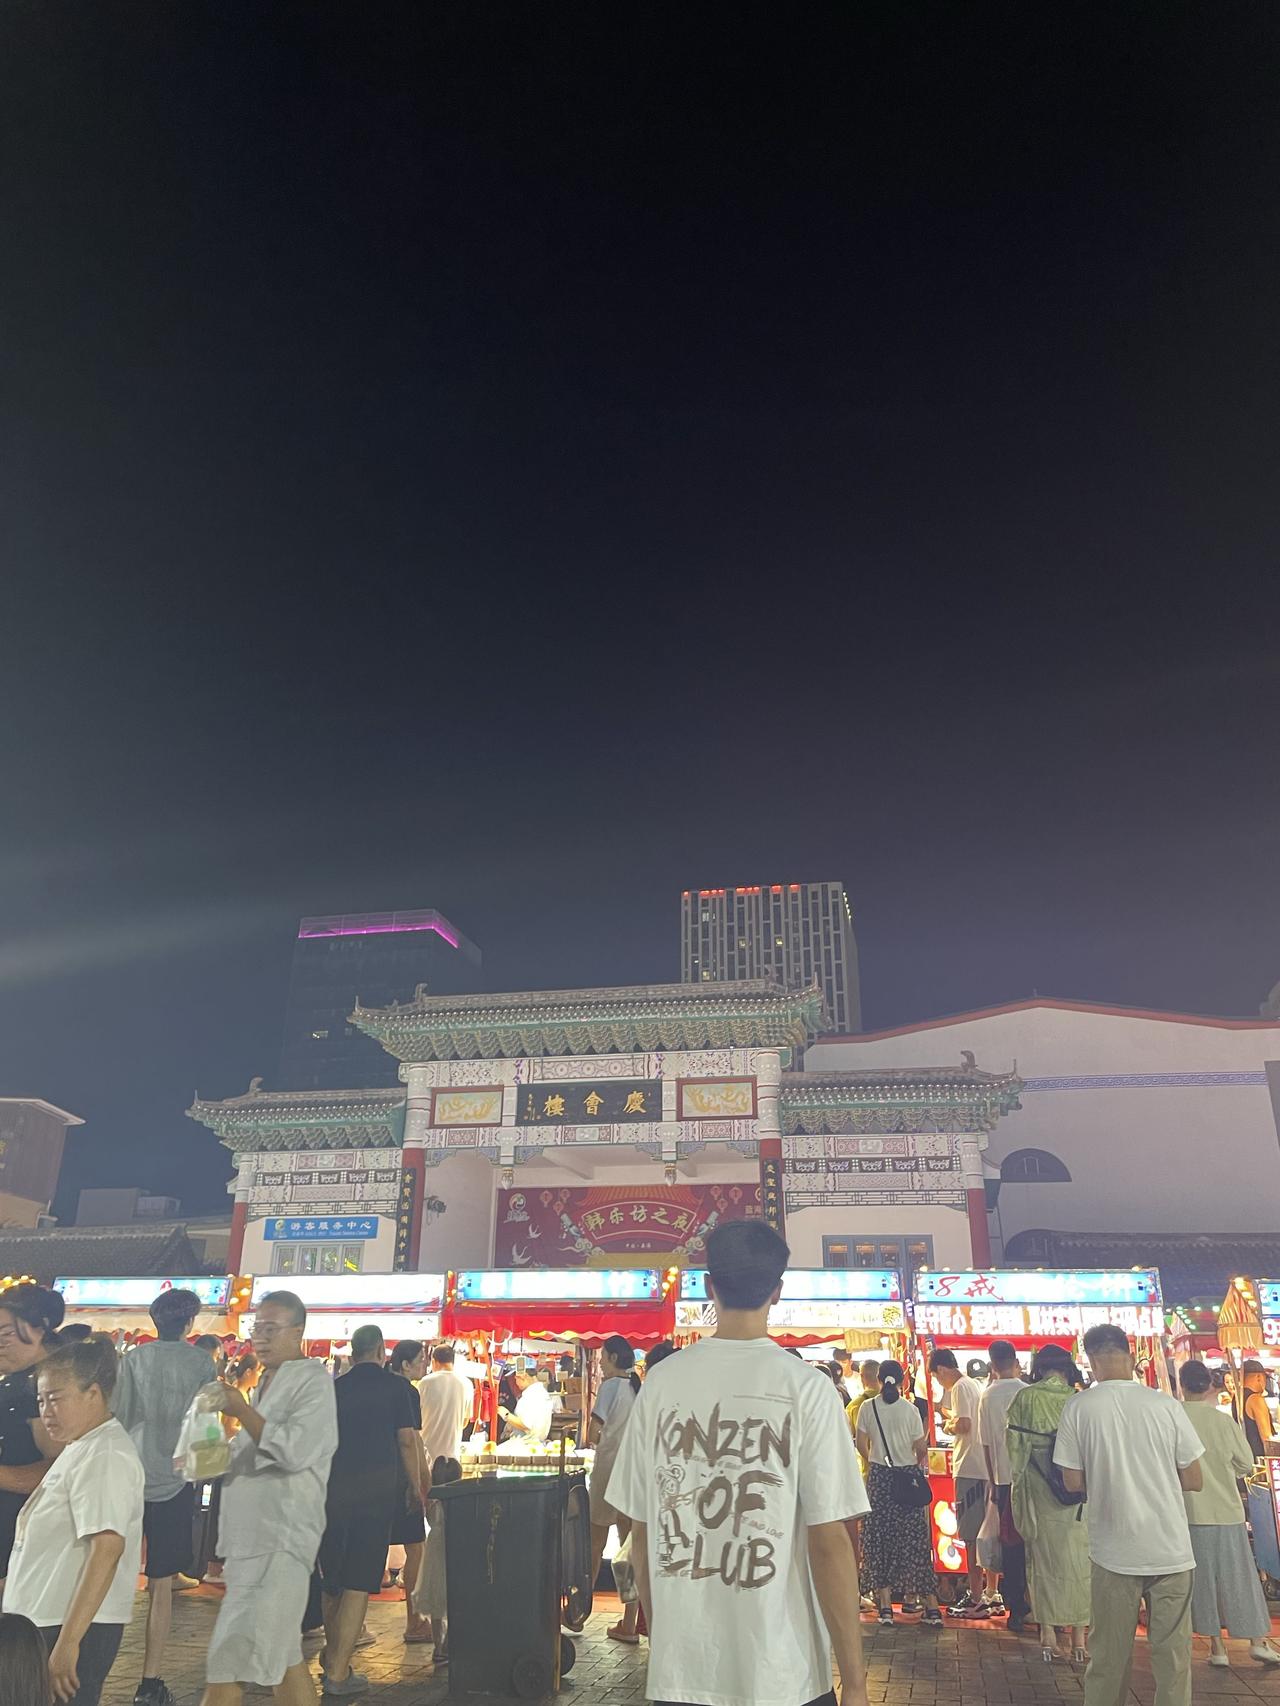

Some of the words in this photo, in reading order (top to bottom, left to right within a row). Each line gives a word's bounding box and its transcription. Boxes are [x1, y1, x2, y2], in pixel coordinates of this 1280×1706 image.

[290, 1220, 372, 1231] 游客服务中心
[584, 1204, 690, 1233] 韩乐坊之夜
[653, 1402, 792, 1468] KONZEN
[698, 1470, 784, 1538] OF
